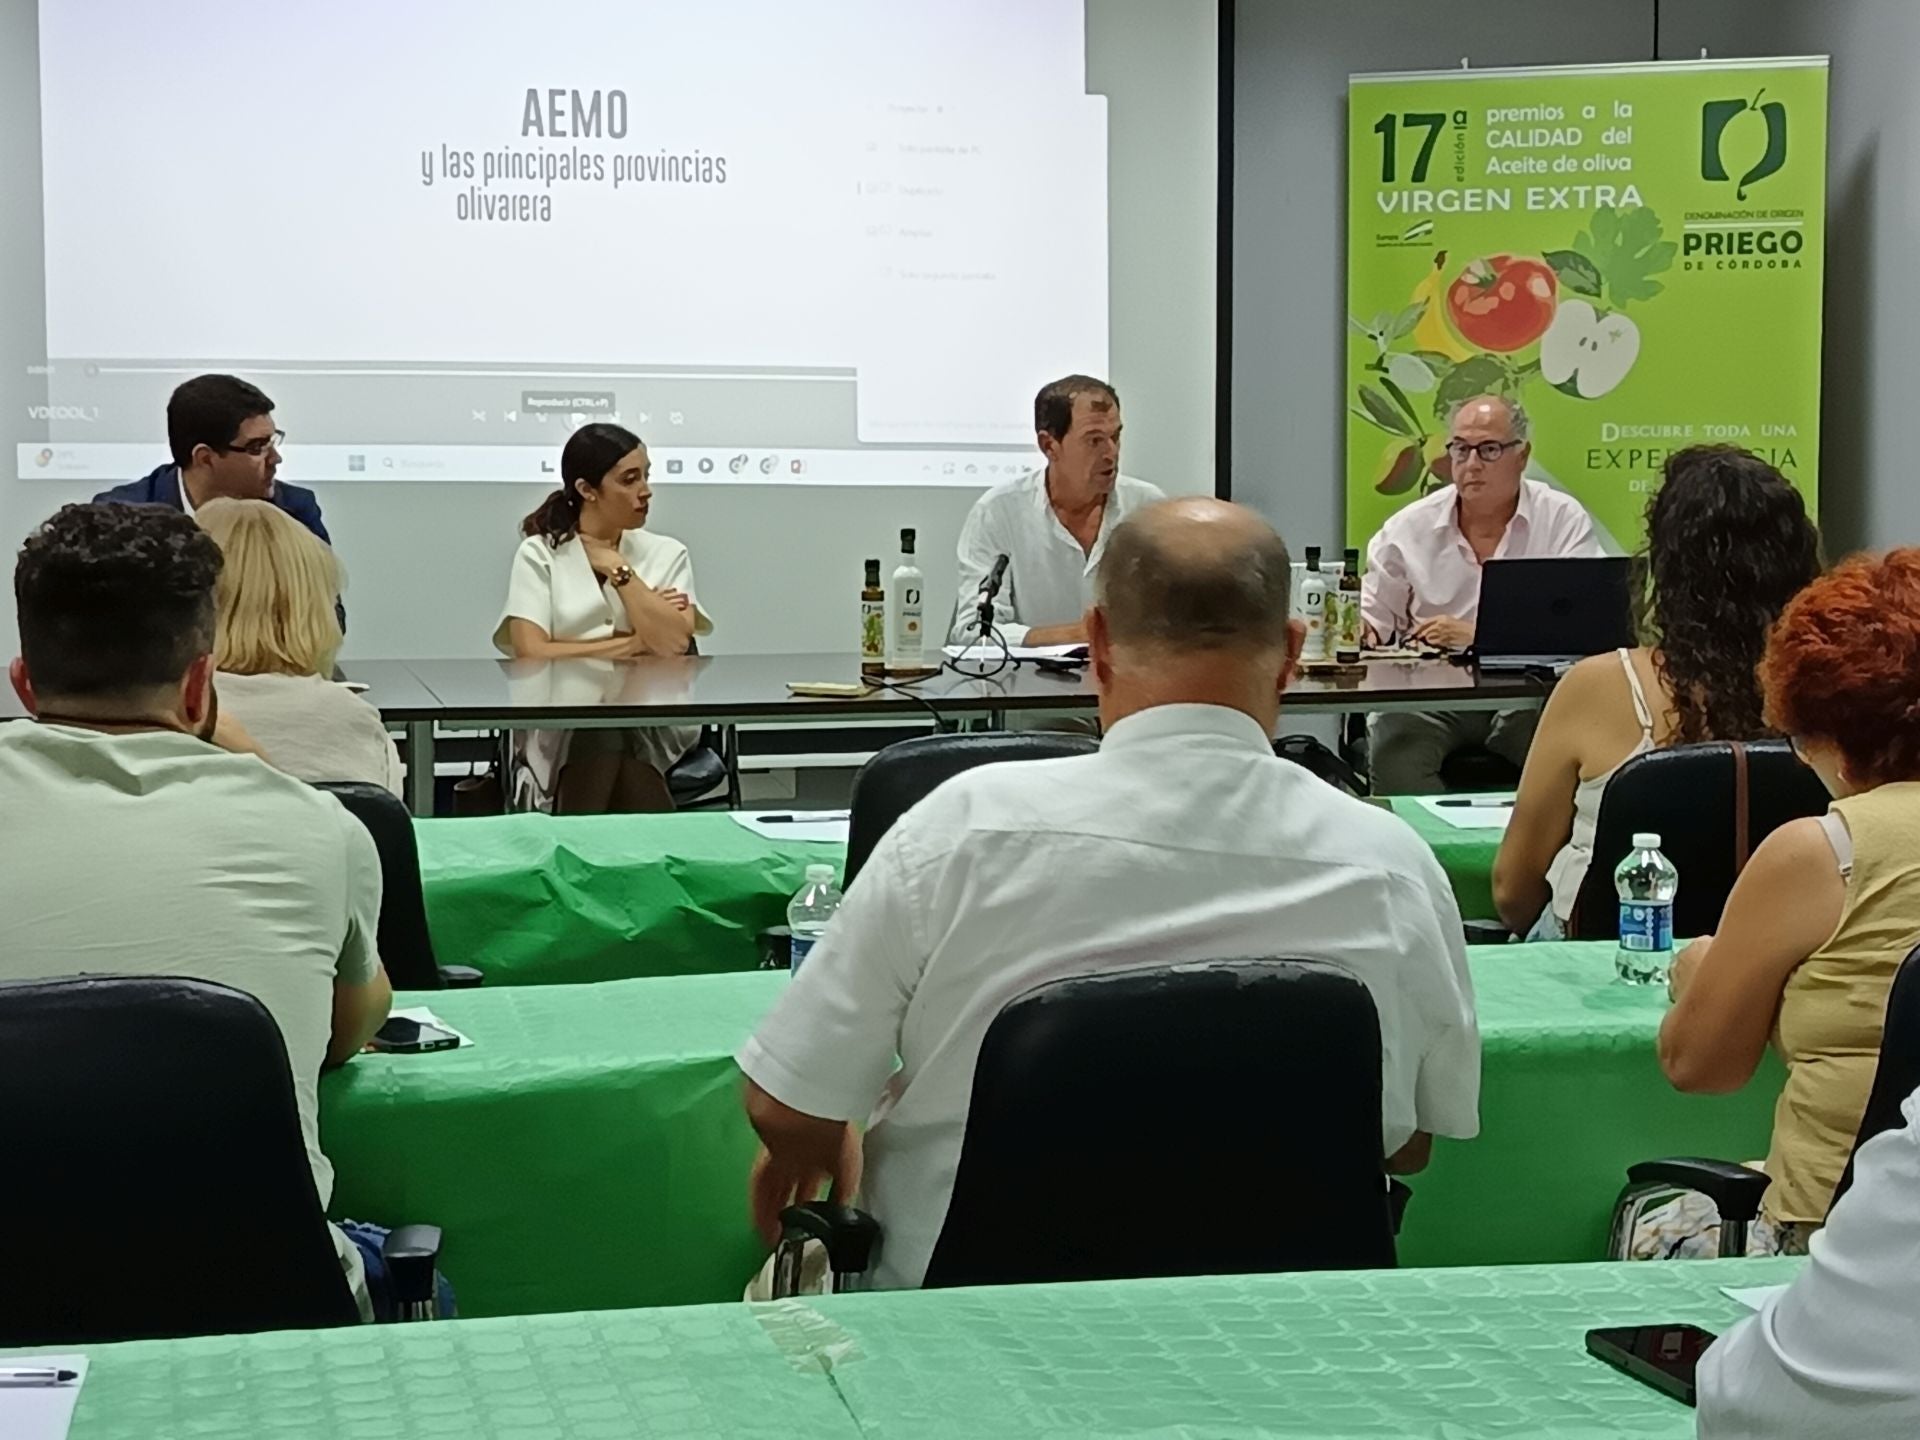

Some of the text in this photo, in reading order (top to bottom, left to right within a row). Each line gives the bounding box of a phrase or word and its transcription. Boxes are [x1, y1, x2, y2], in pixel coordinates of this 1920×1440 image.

[521, 88, 628, 139] AEMO
[1486, 100, 1632, 125] premios a la
[1486, 126, 1632, 148] CALIDAD del
[421, 143, 726, 189] y las principales provincias
[1453, 133, 1465, 183] edición
[1486, 153, 1632, 175] Aceite de oliva
[457, 186, 551, 222] olivarera
[1377, 185, 1643, 213] VIRGEN EXTRA
[1756, 210, 1768, 218] DE
[1770, 209, 1804, 218] ORIGEN
[1684, 230, 1803, 256] PRIEGO
[1684, 259, 1802, 271] DE CÓRDOBA
[1703, 424, 1750, 437] TODA
[1760, 424, 1798, 437] UNA
